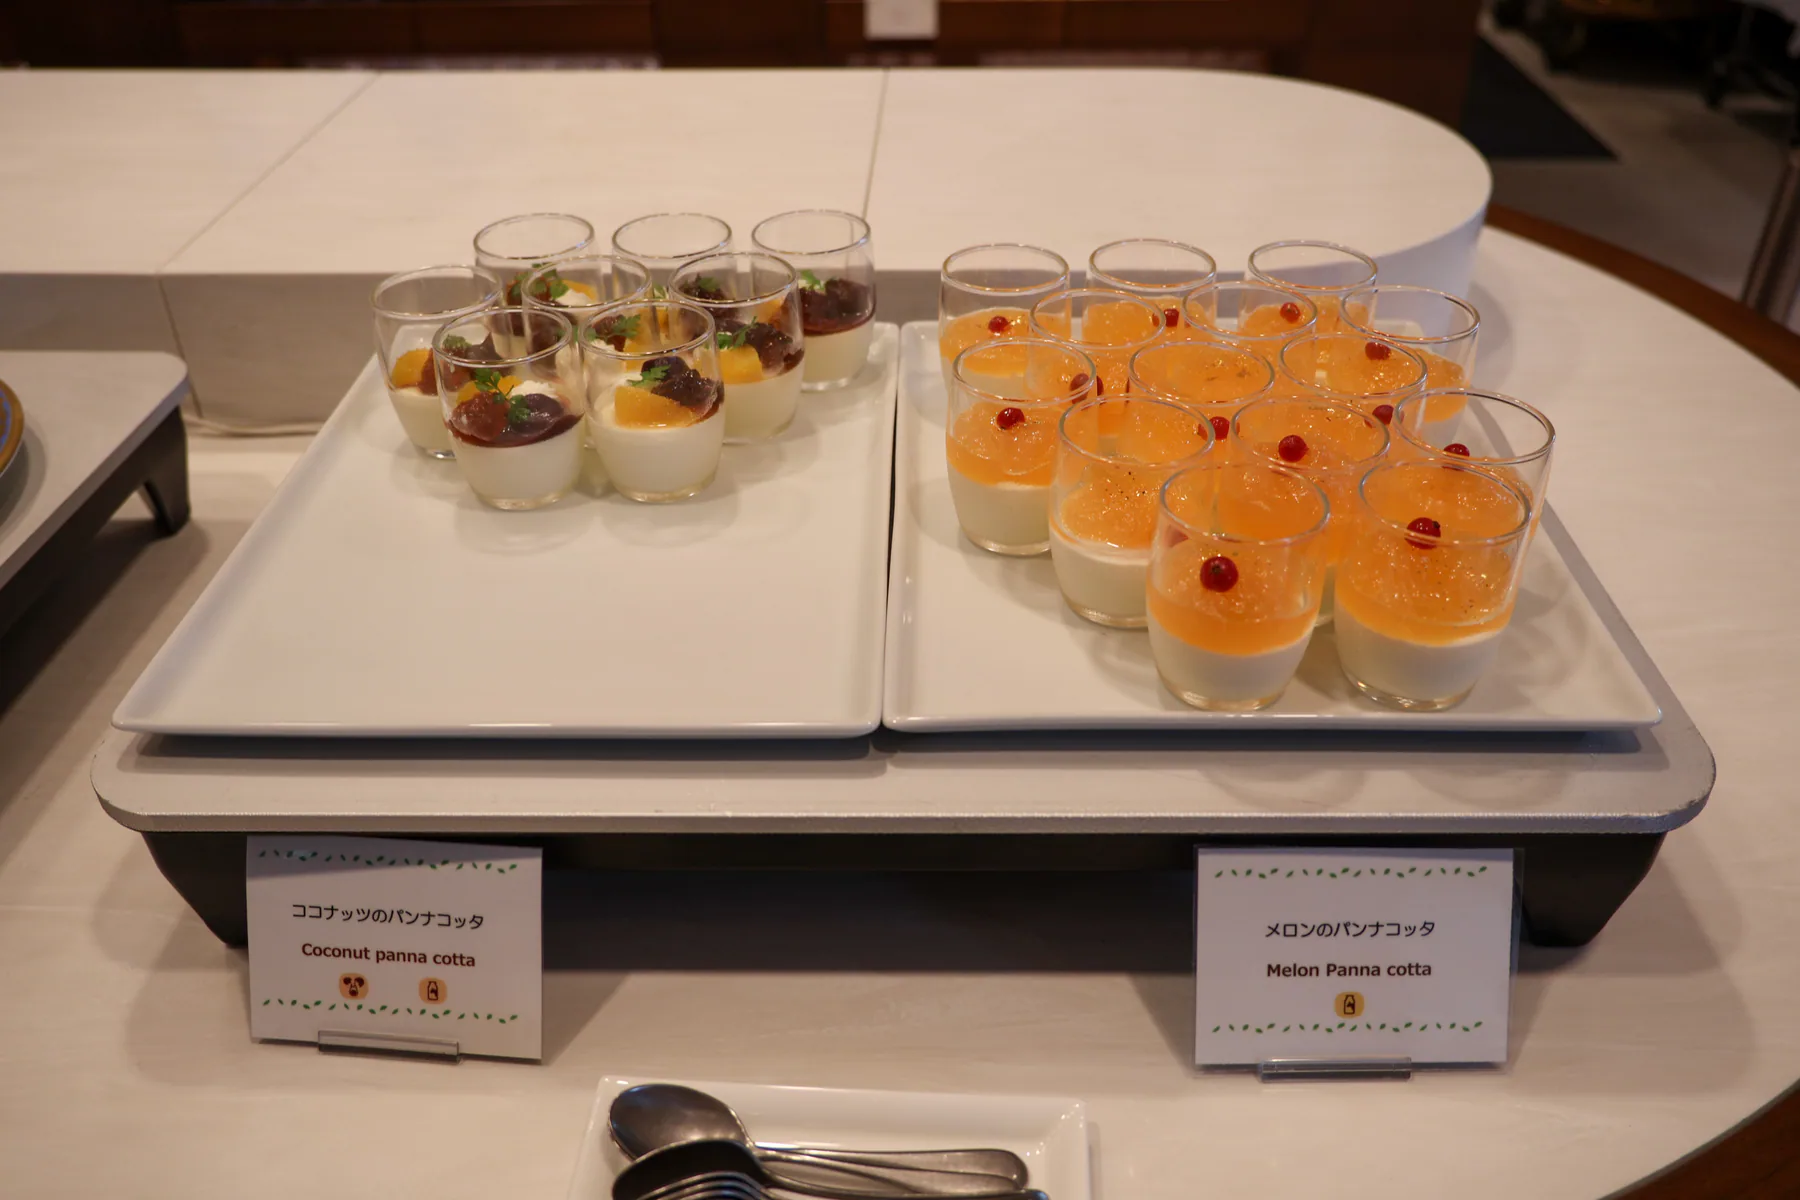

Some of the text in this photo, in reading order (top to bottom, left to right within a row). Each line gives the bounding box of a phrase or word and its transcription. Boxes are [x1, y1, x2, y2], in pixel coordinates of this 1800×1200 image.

[292, 903, 484, 930] ココナッツのパンナコッタ
[1265, 921, 1436, 938] メロンのパンナコッタ
[301, 943, 476, 967] Coconut panna cotta
[1267, 963, 1432, 977] Melon Panna cotta
